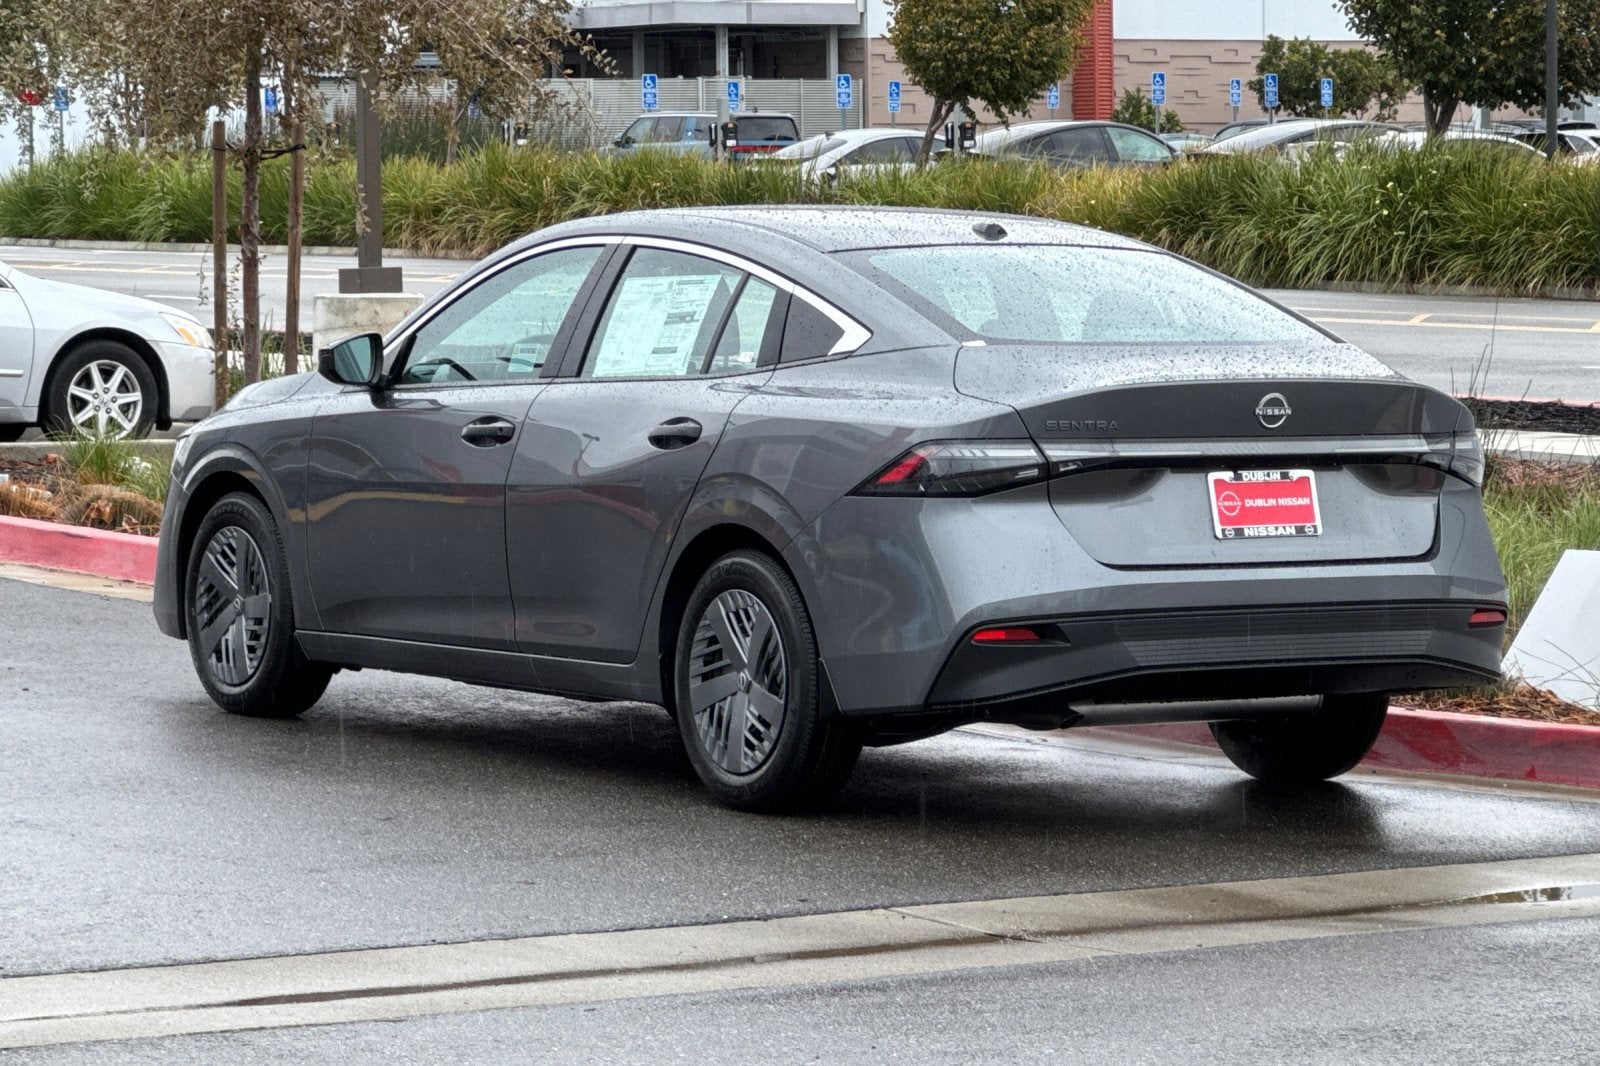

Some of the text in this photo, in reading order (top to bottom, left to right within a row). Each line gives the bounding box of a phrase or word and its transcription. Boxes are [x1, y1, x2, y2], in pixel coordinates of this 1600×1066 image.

[1255, 407, 1292, 416] NISSAN
[1045, 420, 1119, 432] SENTRA
[1242, 471, 1281, 481] DUBLIN
[1245, 497, 1310, 507] DUBLIN NISSAN
[1244, 525, 1296, 537] NISSAN
